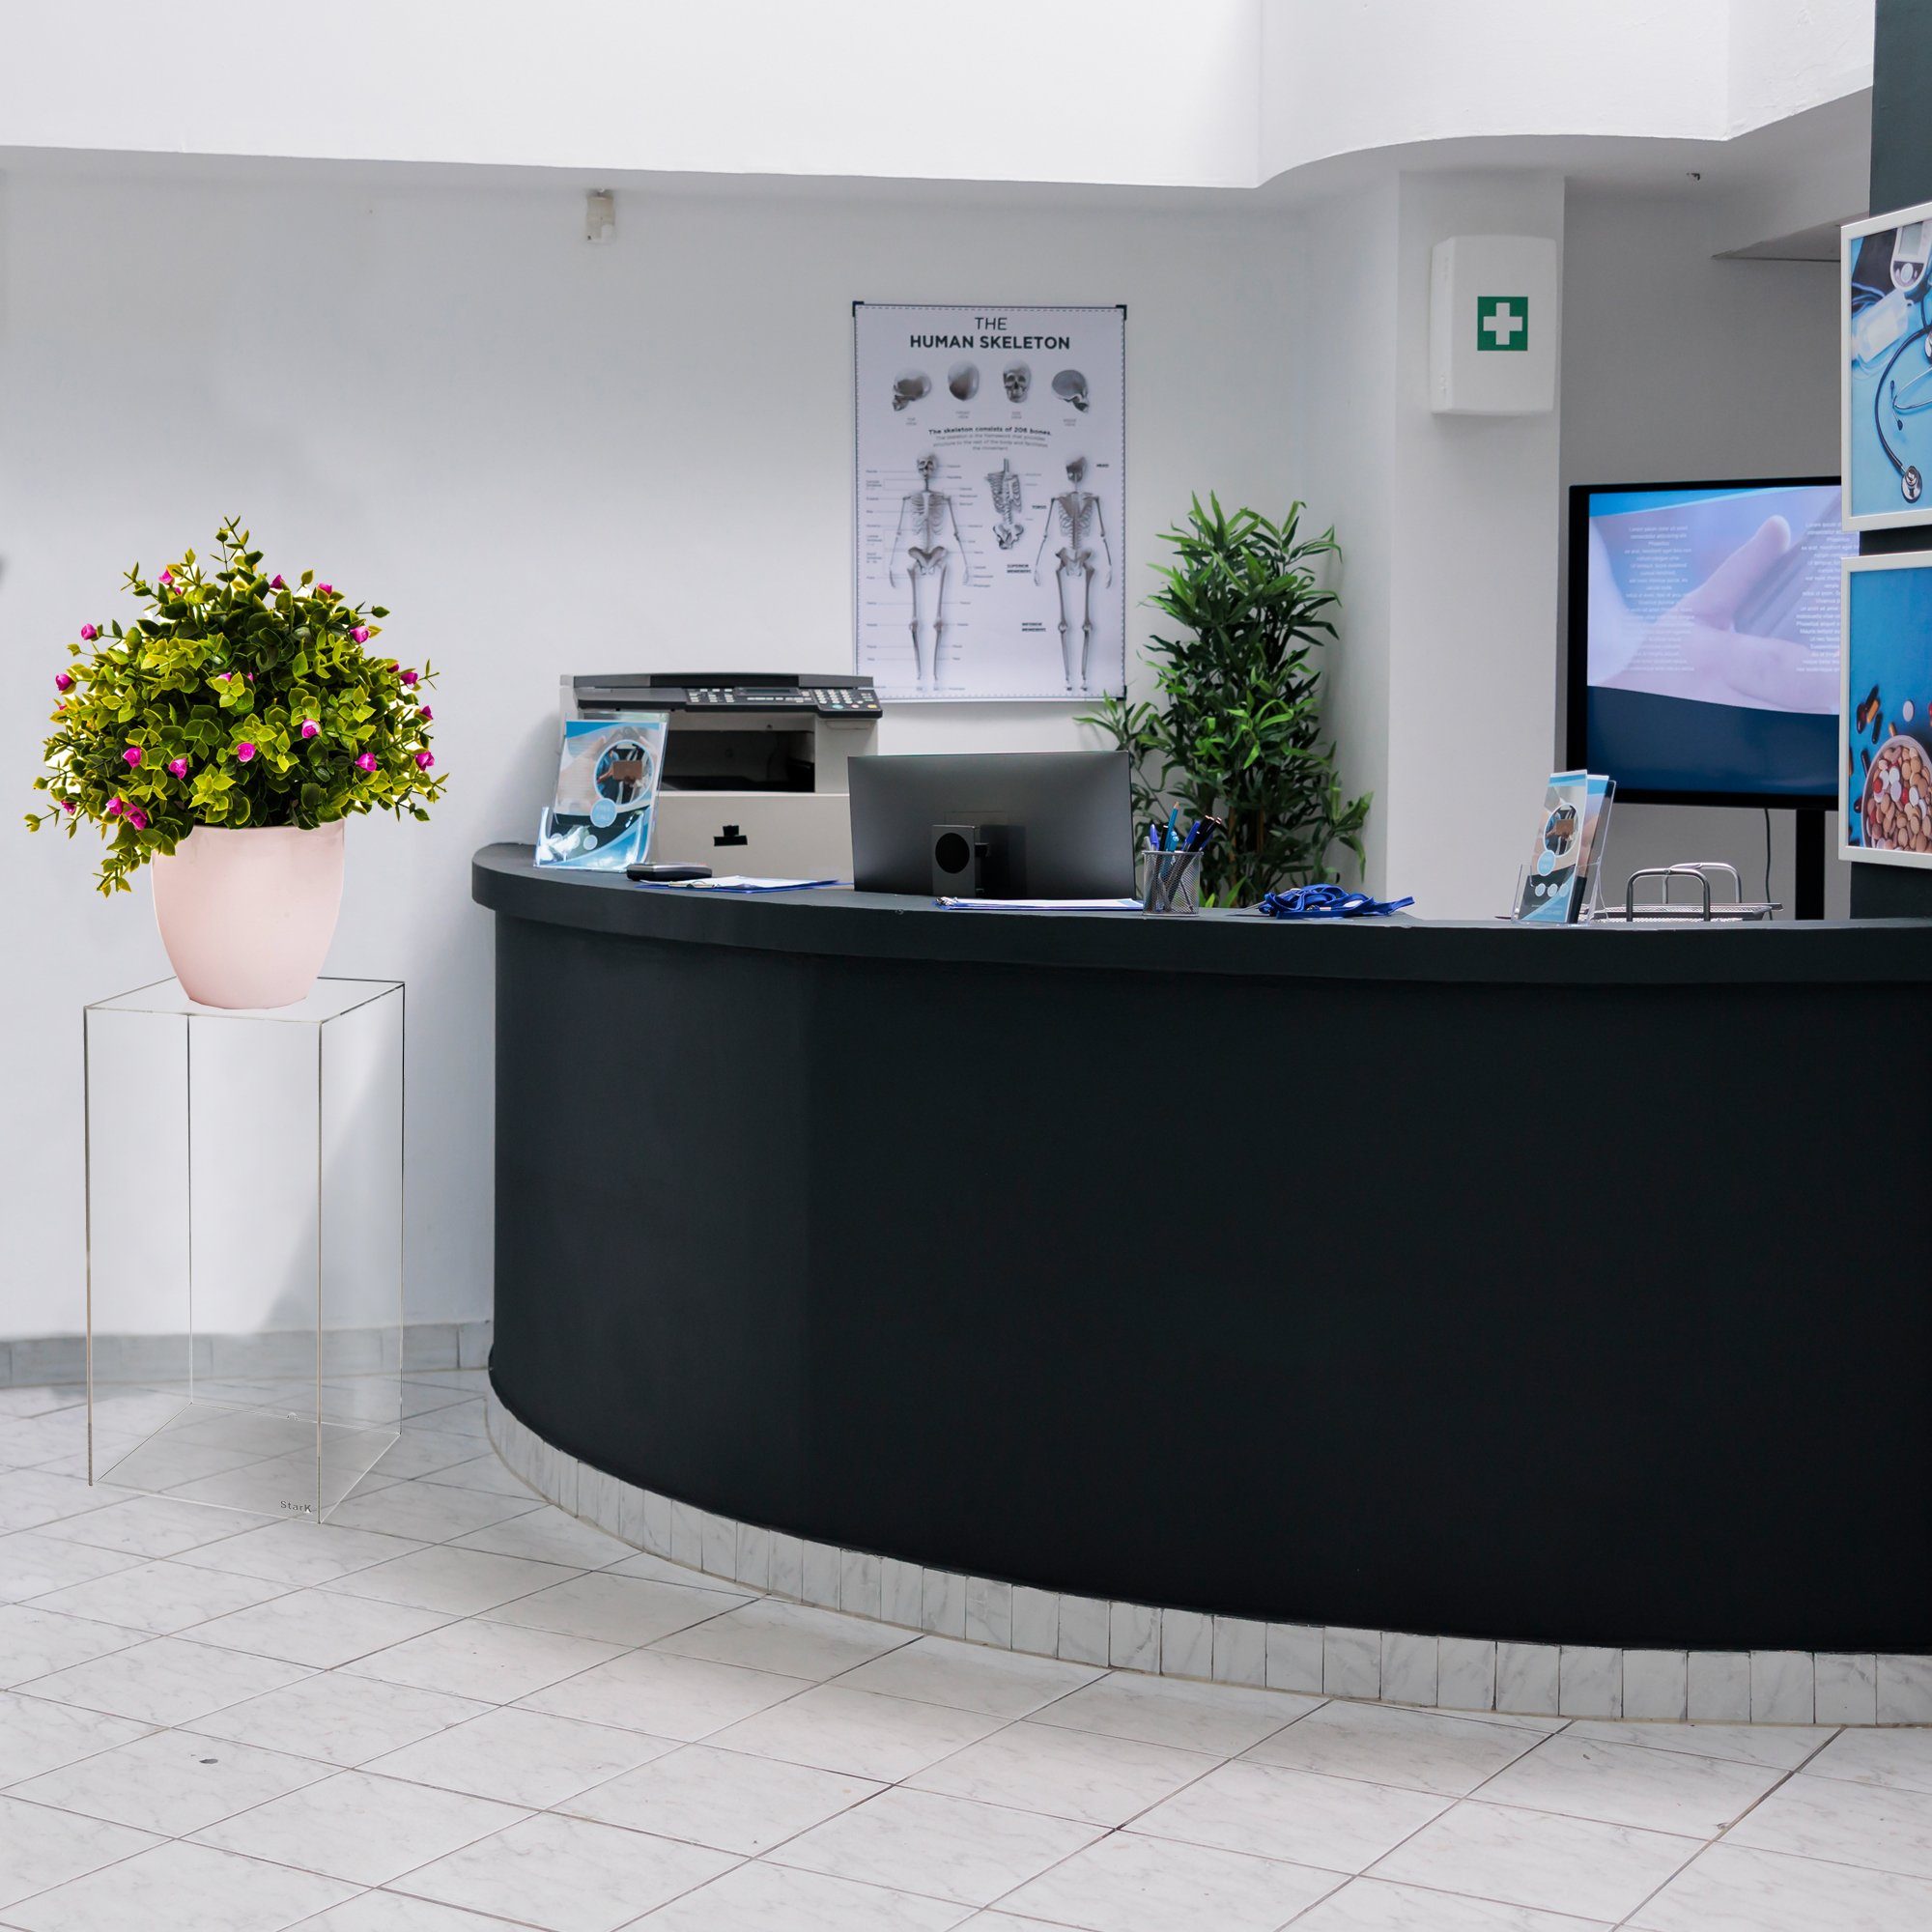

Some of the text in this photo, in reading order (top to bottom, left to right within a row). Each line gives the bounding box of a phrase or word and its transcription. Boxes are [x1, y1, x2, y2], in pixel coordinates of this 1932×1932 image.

[974, 317, 1008, 330] THE
[909, 335, 1070, 350] HUMAN SKELETON
